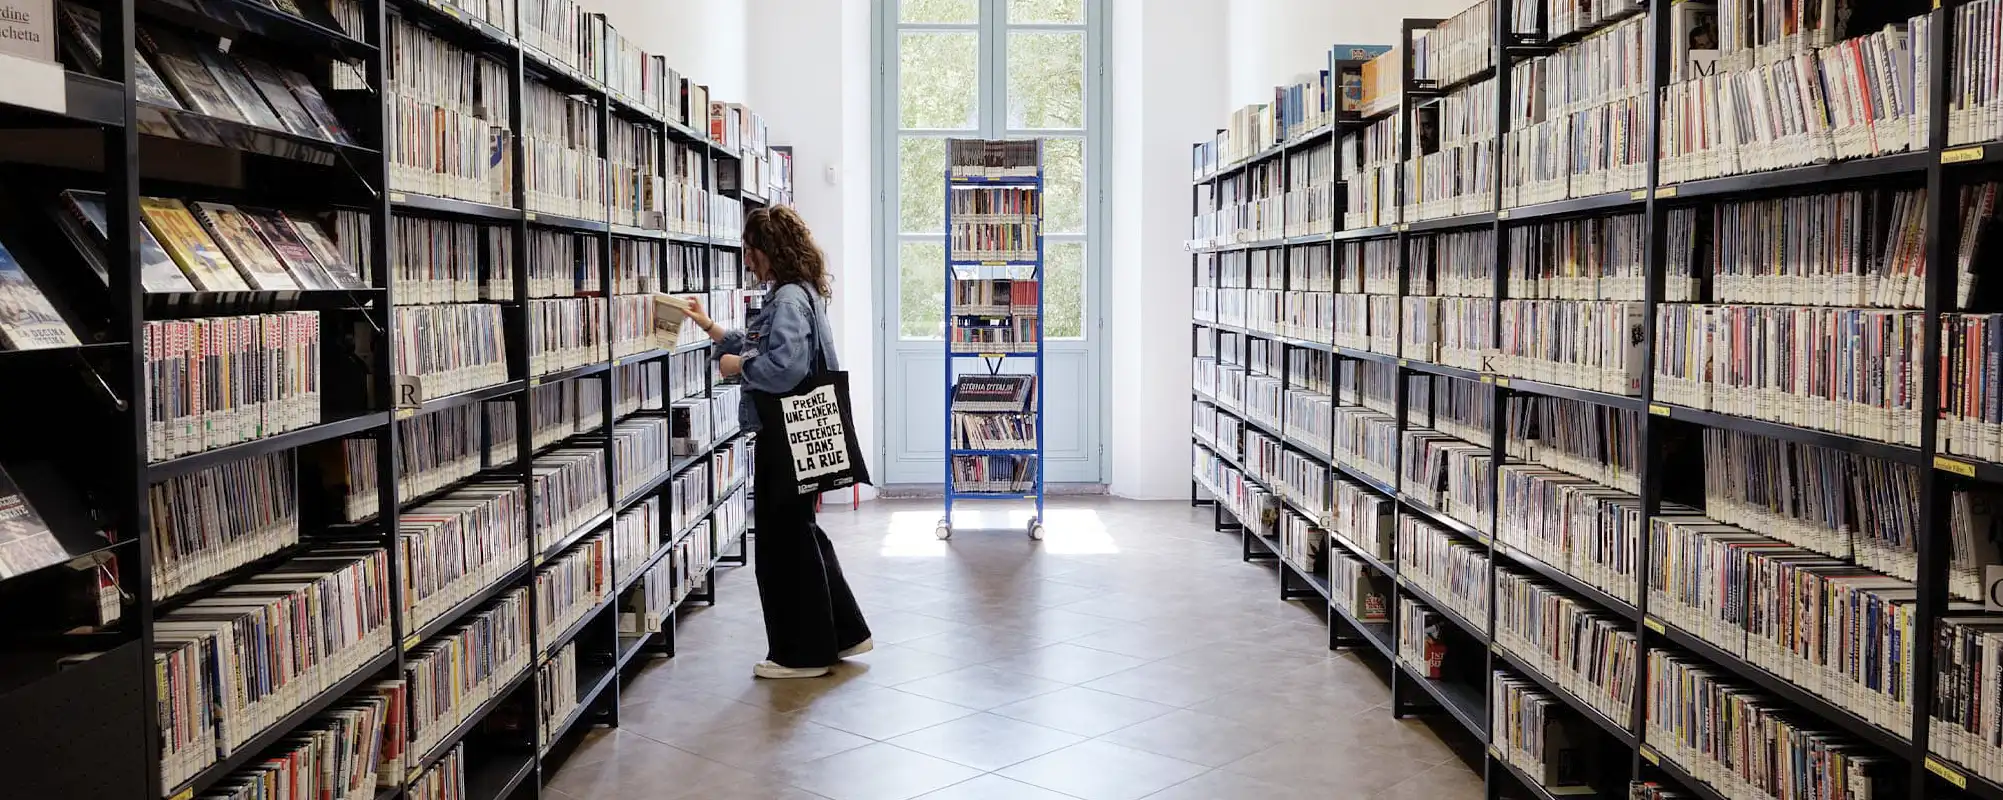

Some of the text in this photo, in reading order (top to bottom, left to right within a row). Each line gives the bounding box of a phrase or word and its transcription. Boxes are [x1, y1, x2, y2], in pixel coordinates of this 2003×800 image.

[0, 26, 40, 43] chetta
[1691, 59, 1718, 79] M
[1481, 355, 1497, 372] K
[400, 384, 418, 405] R
[792, 392, 827, 410] PRENEZ
[785, 402, 839, 424] UNE CAMERA
[816, 416, 828, 427] ET
[789, 423, 842, 444] DESCENDEZ
[806, 438, 834, 456] DANS
[1529, 446, 1540, 462] L
[796, 450, 845, 472] LA RUE
[1320, 515, 1331, 528] G
[647, 616, 658, 631] U
